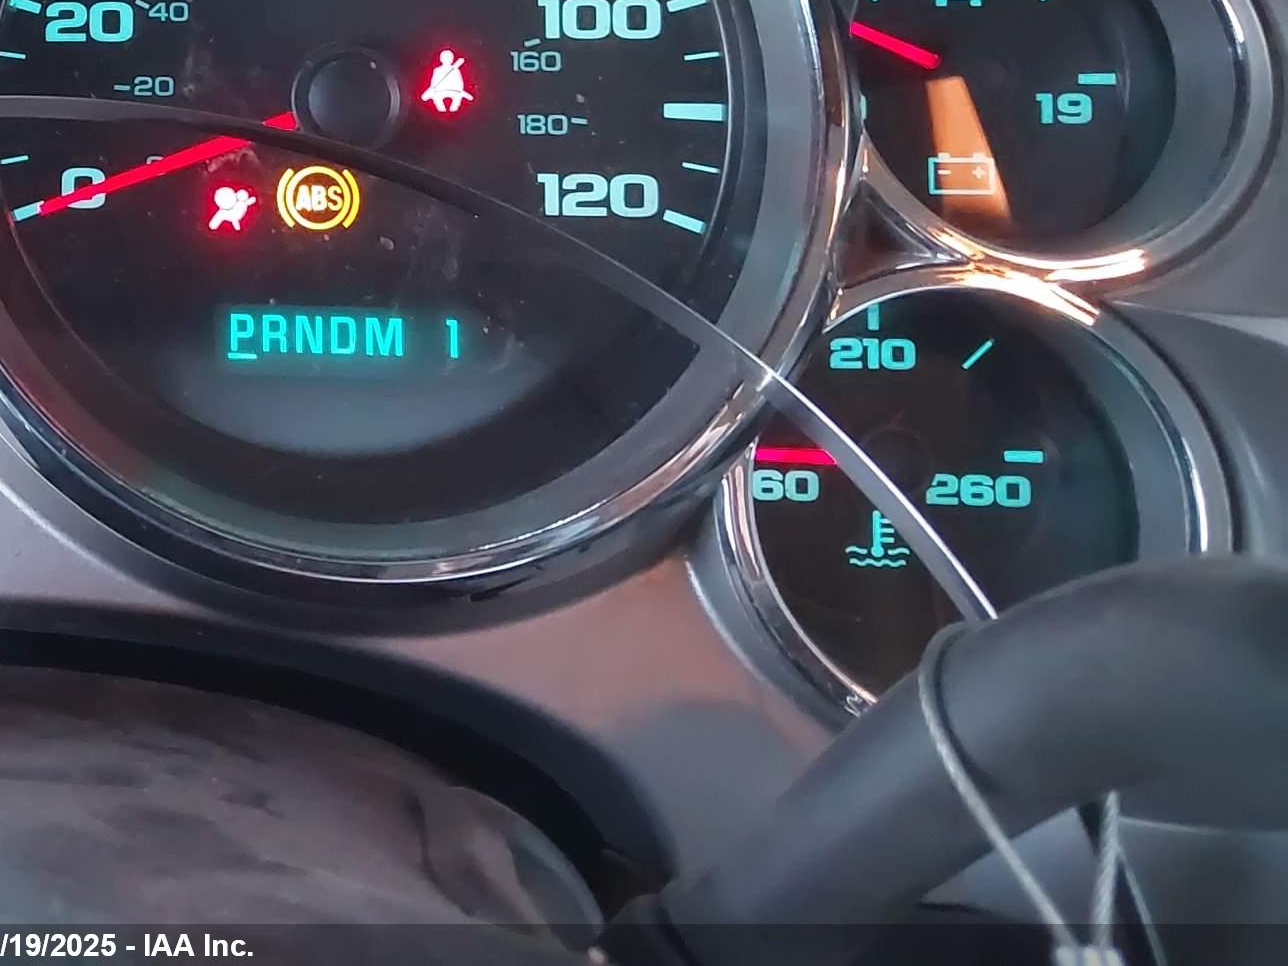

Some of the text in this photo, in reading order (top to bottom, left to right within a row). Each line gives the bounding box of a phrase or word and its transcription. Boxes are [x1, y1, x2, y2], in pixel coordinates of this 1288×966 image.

[44, 2, 133, 42] 20
[148, 2, 190, 22] 40
[511, 51, 561, 71] 160
[132, 76, 175, 96] 20
[1036, 93, 1092, 123] 19
[517, 115, 569, 135] 180
[62, 167, 106, 209] 0
[296, 185, 343, 211] ABS
[538, 174, 658, 217] 120
[444, 318, 460, 358] 1
[830, 338, 915, 369] 210
[926, 474, 1031, 507] 260
